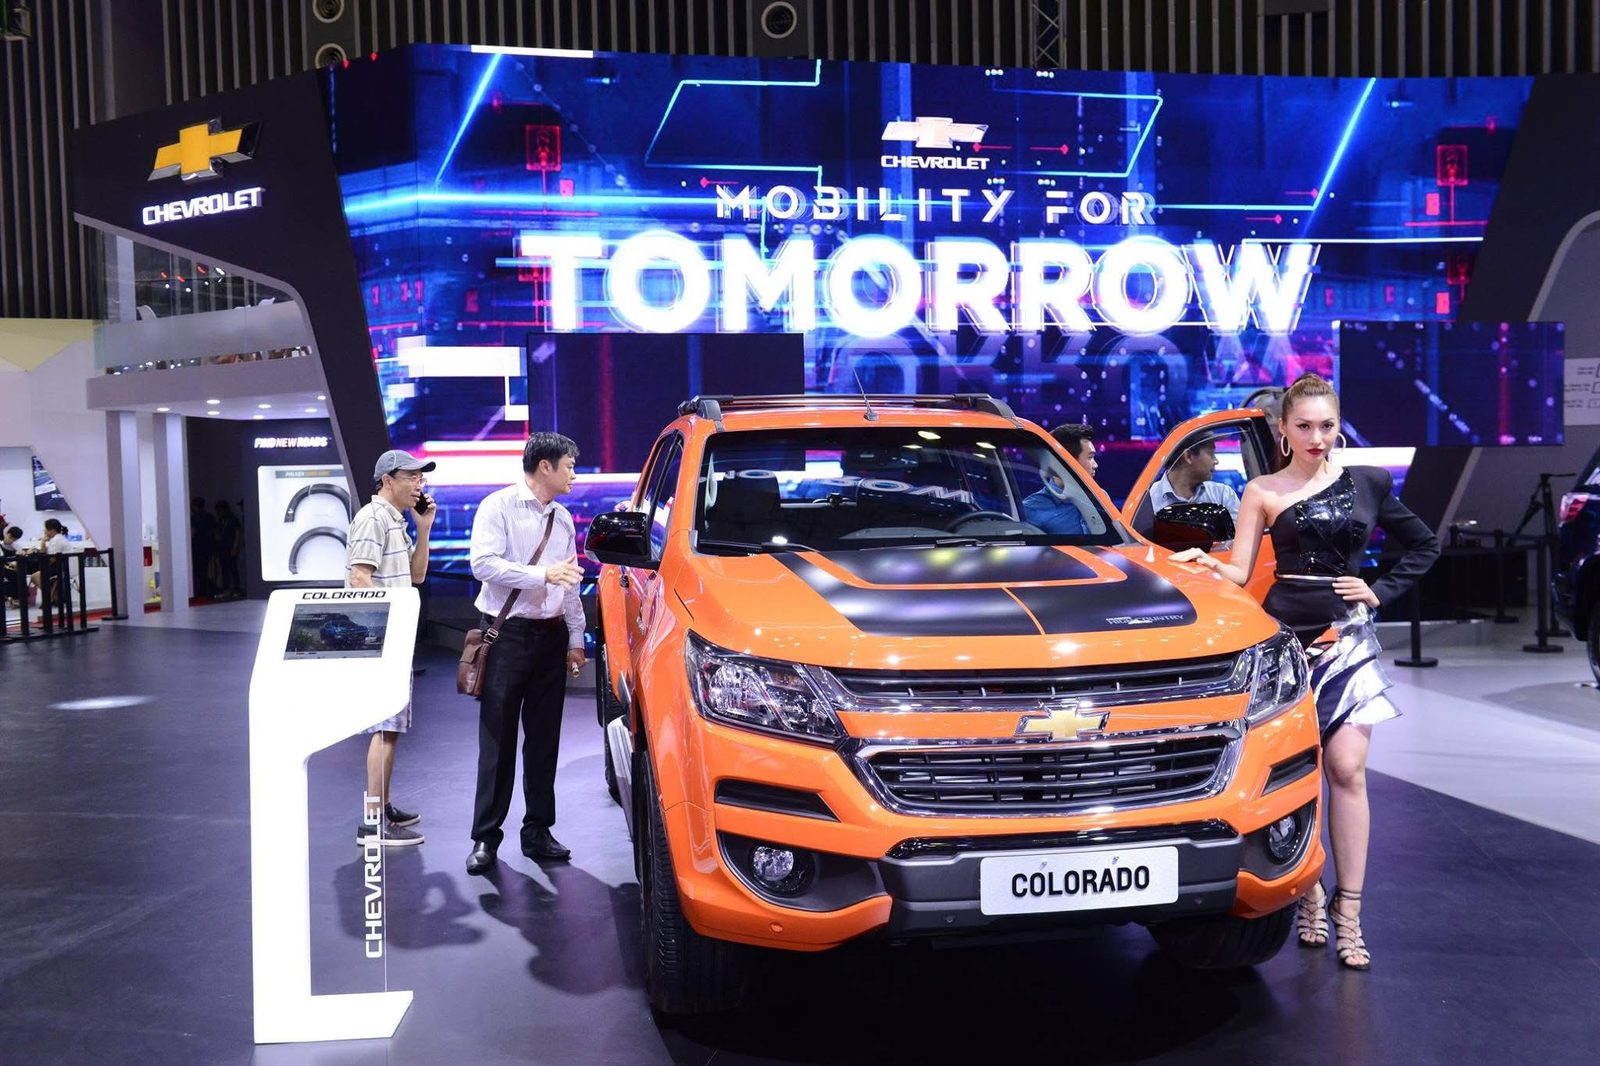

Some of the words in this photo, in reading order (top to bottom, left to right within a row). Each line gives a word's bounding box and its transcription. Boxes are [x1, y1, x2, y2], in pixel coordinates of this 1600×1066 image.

[880, 154, 990, 171] CHEVROLET
[142, 186, 263, 226] CHEVROLET
[716, 184, 1013, 223] MOBILITY
[1046, 190, 1155, 225] FOR
[516, 230, 1320, 335] TOMORROW
[276, 438, 297, 448] NEW
[302, 590, 387, 600] COLORADO
[363, 790, 383, 959] CHEVROLET
[1011, 865, 1150, 898] COLORADO
